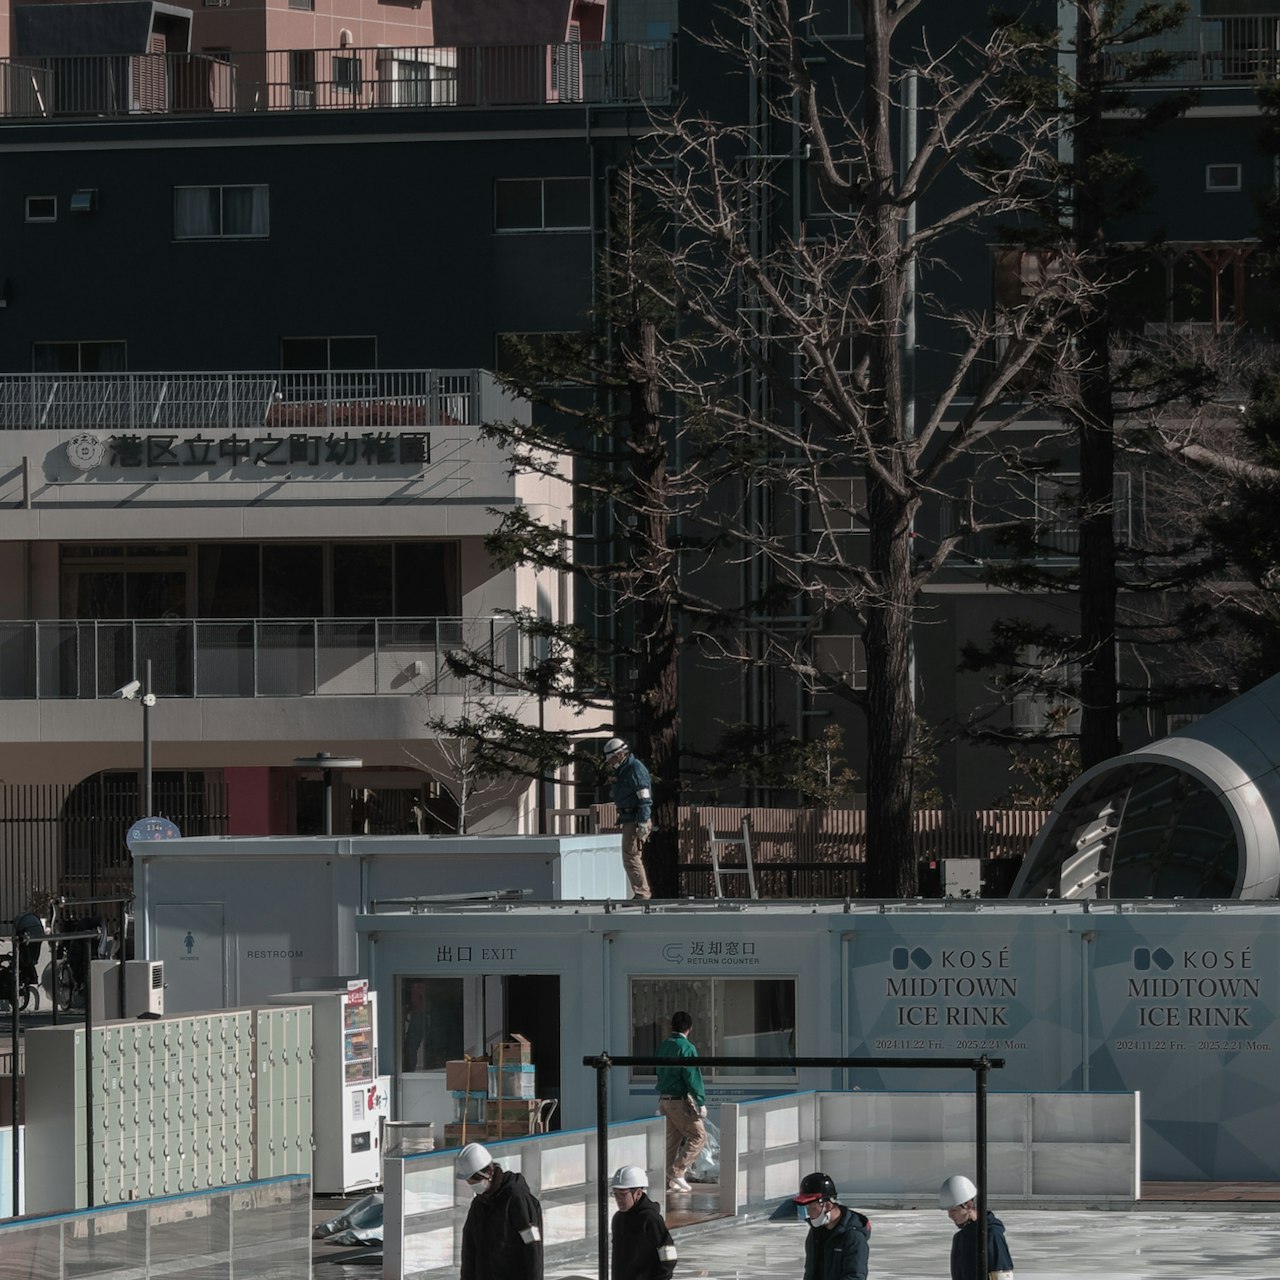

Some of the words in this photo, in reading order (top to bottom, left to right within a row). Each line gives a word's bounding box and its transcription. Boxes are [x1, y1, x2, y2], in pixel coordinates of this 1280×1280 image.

[108, 432, 432, 467] 港区立中之町幼稚園
[437, 946, 471, 962] 出口
[482, 949, 516, 960] EXIT
[691, 941, 755, 955] 返却窓口
[943, 947, 1008, 968] KOSÉ
[1185, 947, 1251, 968] KOSÉ
[888, 978, 1016, 996] MIDTOWN
[1129, 978, 1259, 997] MIDTOWN
[899, 1007, 938, 1025] ICE
[947, 1007, 1006, 1025] RINK
[1140, 1008, 1180, 1026] ICE
[1189, 1008, 1248, 1026] RINK
